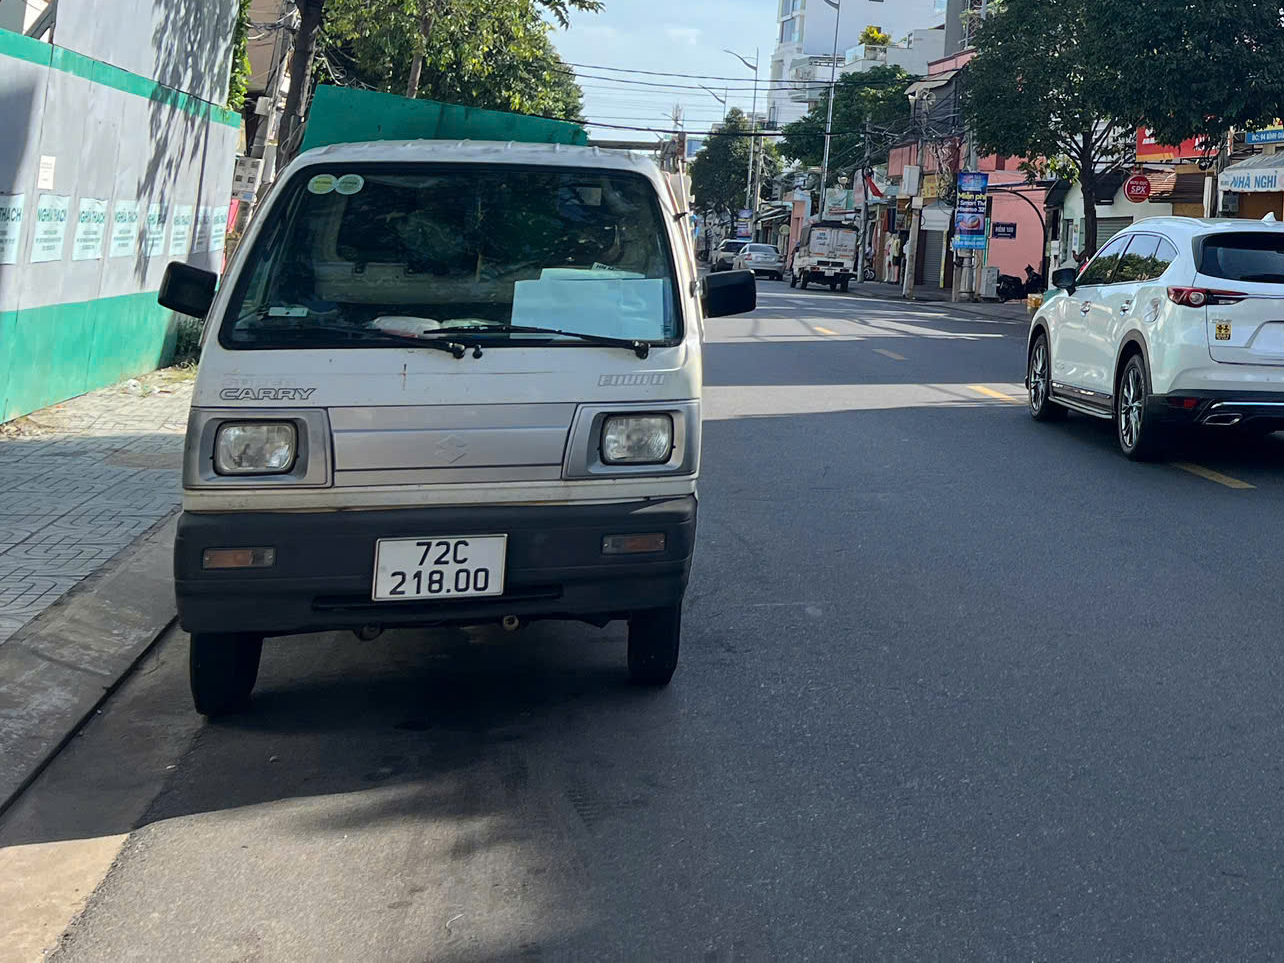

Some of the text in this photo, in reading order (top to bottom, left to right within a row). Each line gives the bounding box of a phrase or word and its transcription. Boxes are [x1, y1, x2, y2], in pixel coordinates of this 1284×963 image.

[1231, 170, 1277, 189] NHÀ NGHỈ
[1131, 186, 1147, 194] SPX
[220, 387, 317, 401] CARRY
[416, 539, 470, 566] 72C
[389, 567, 490, 596] 218.00
